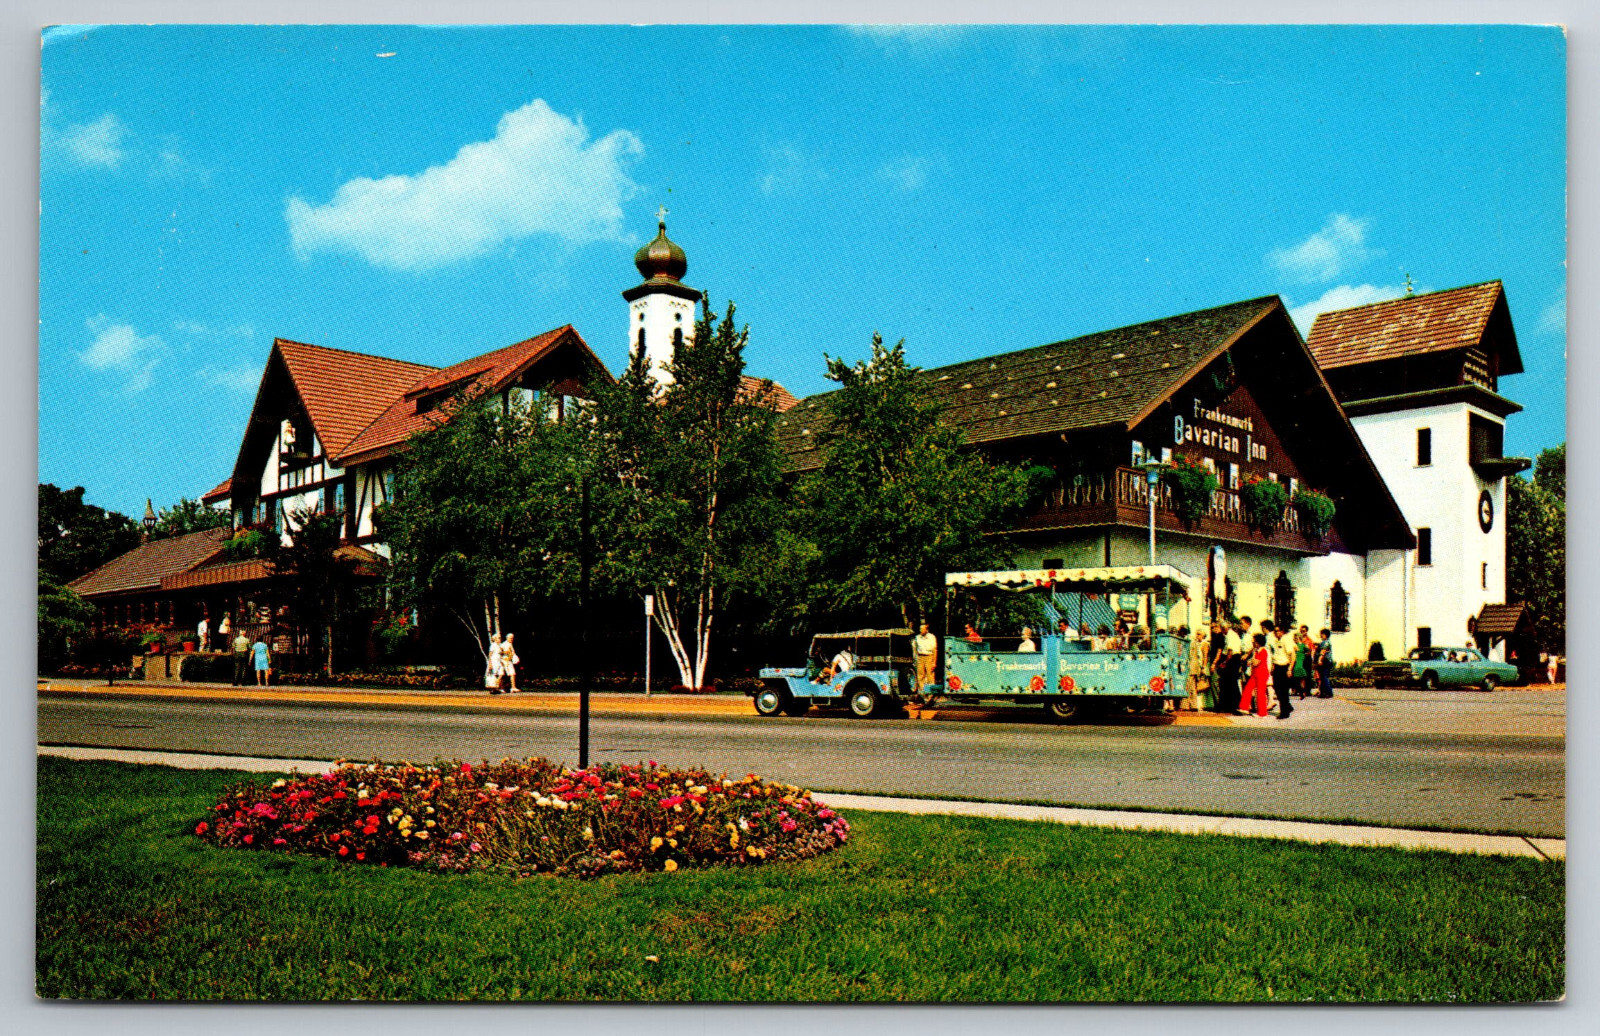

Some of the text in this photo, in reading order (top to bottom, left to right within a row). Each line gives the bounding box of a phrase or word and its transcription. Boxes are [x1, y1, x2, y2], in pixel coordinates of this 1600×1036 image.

[1194, 397, 1253, 432] Frankenmuth
[1174, 414, 1267, 463] Bavarian Inn
[1060, 659, 1100, 672] Bavarian
[1103, 660, 1119, 672] Inn
